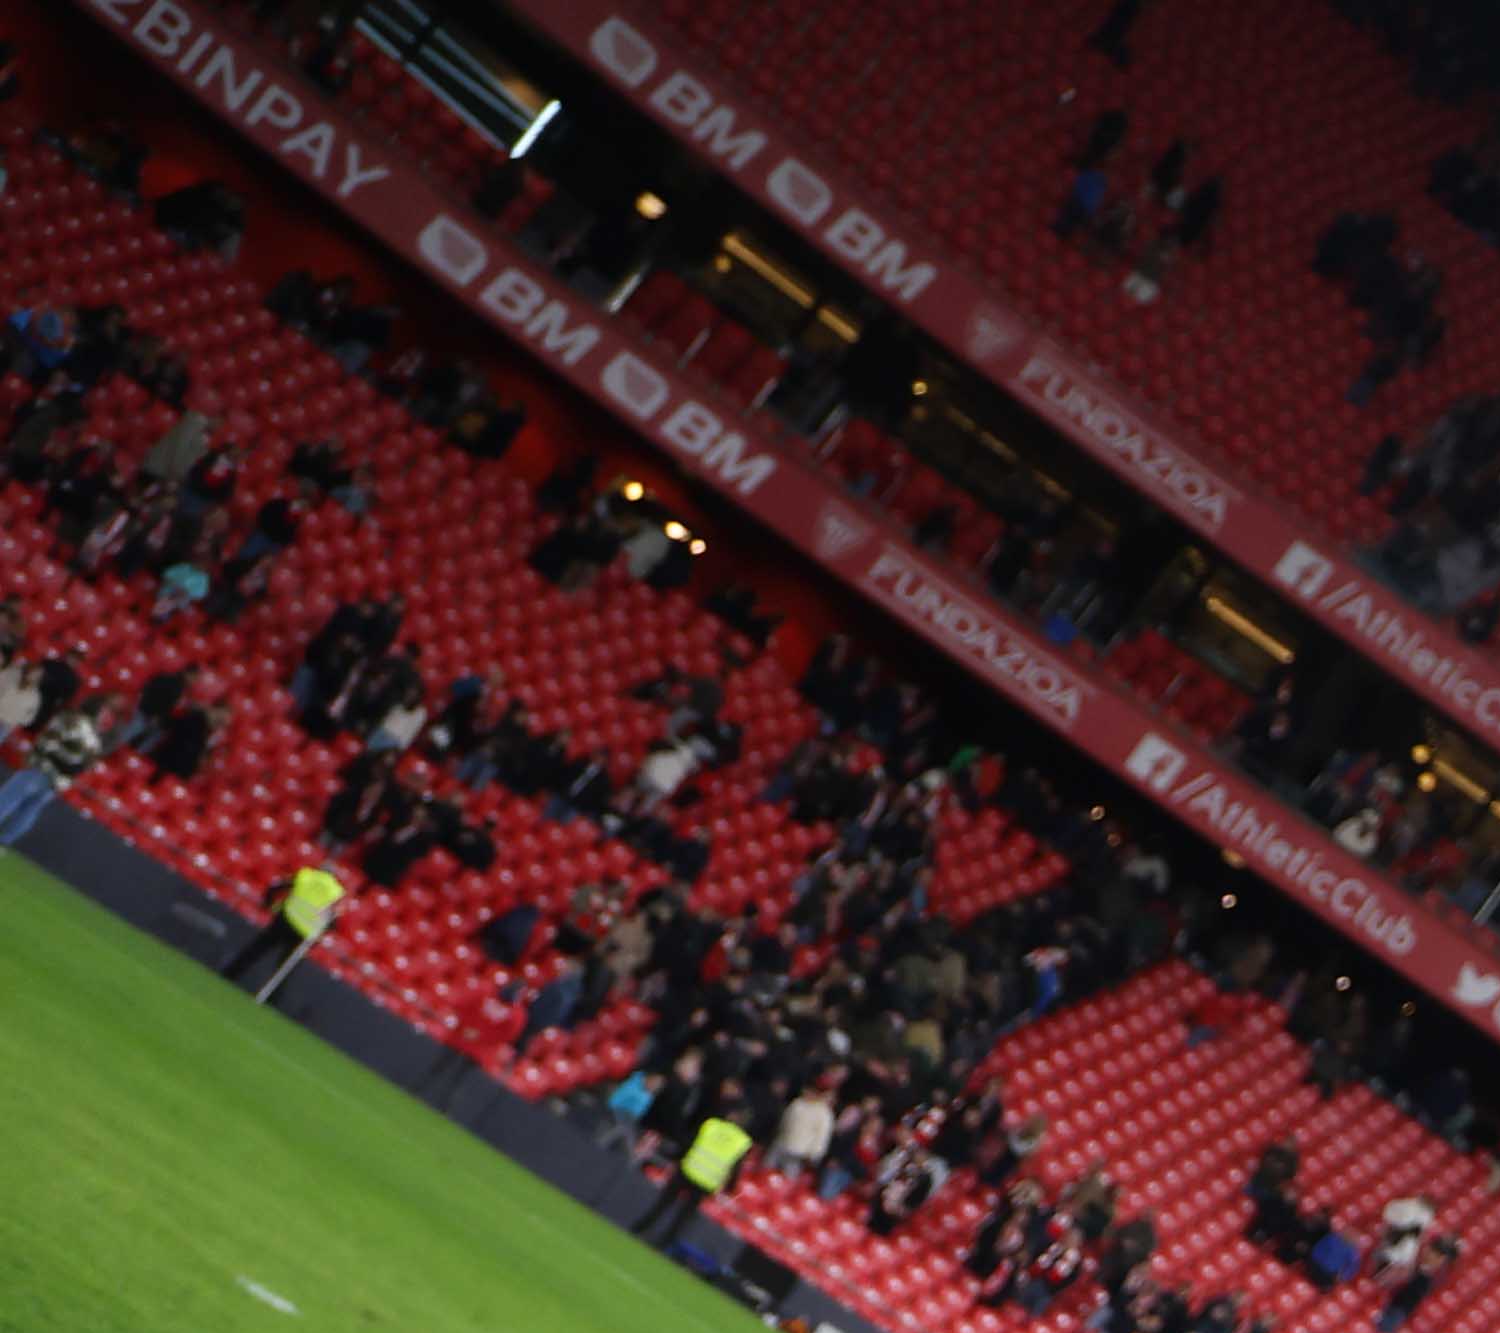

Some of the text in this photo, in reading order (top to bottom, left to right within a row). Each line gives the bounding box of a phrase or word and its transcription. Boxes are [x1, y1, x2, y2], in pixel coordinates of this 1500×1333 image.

[650, 73, 769, 170] BM
[823, 209, 938, 300] BM
[480, 270, 602, 365] BM
[660, 401, 776, 494] BM
